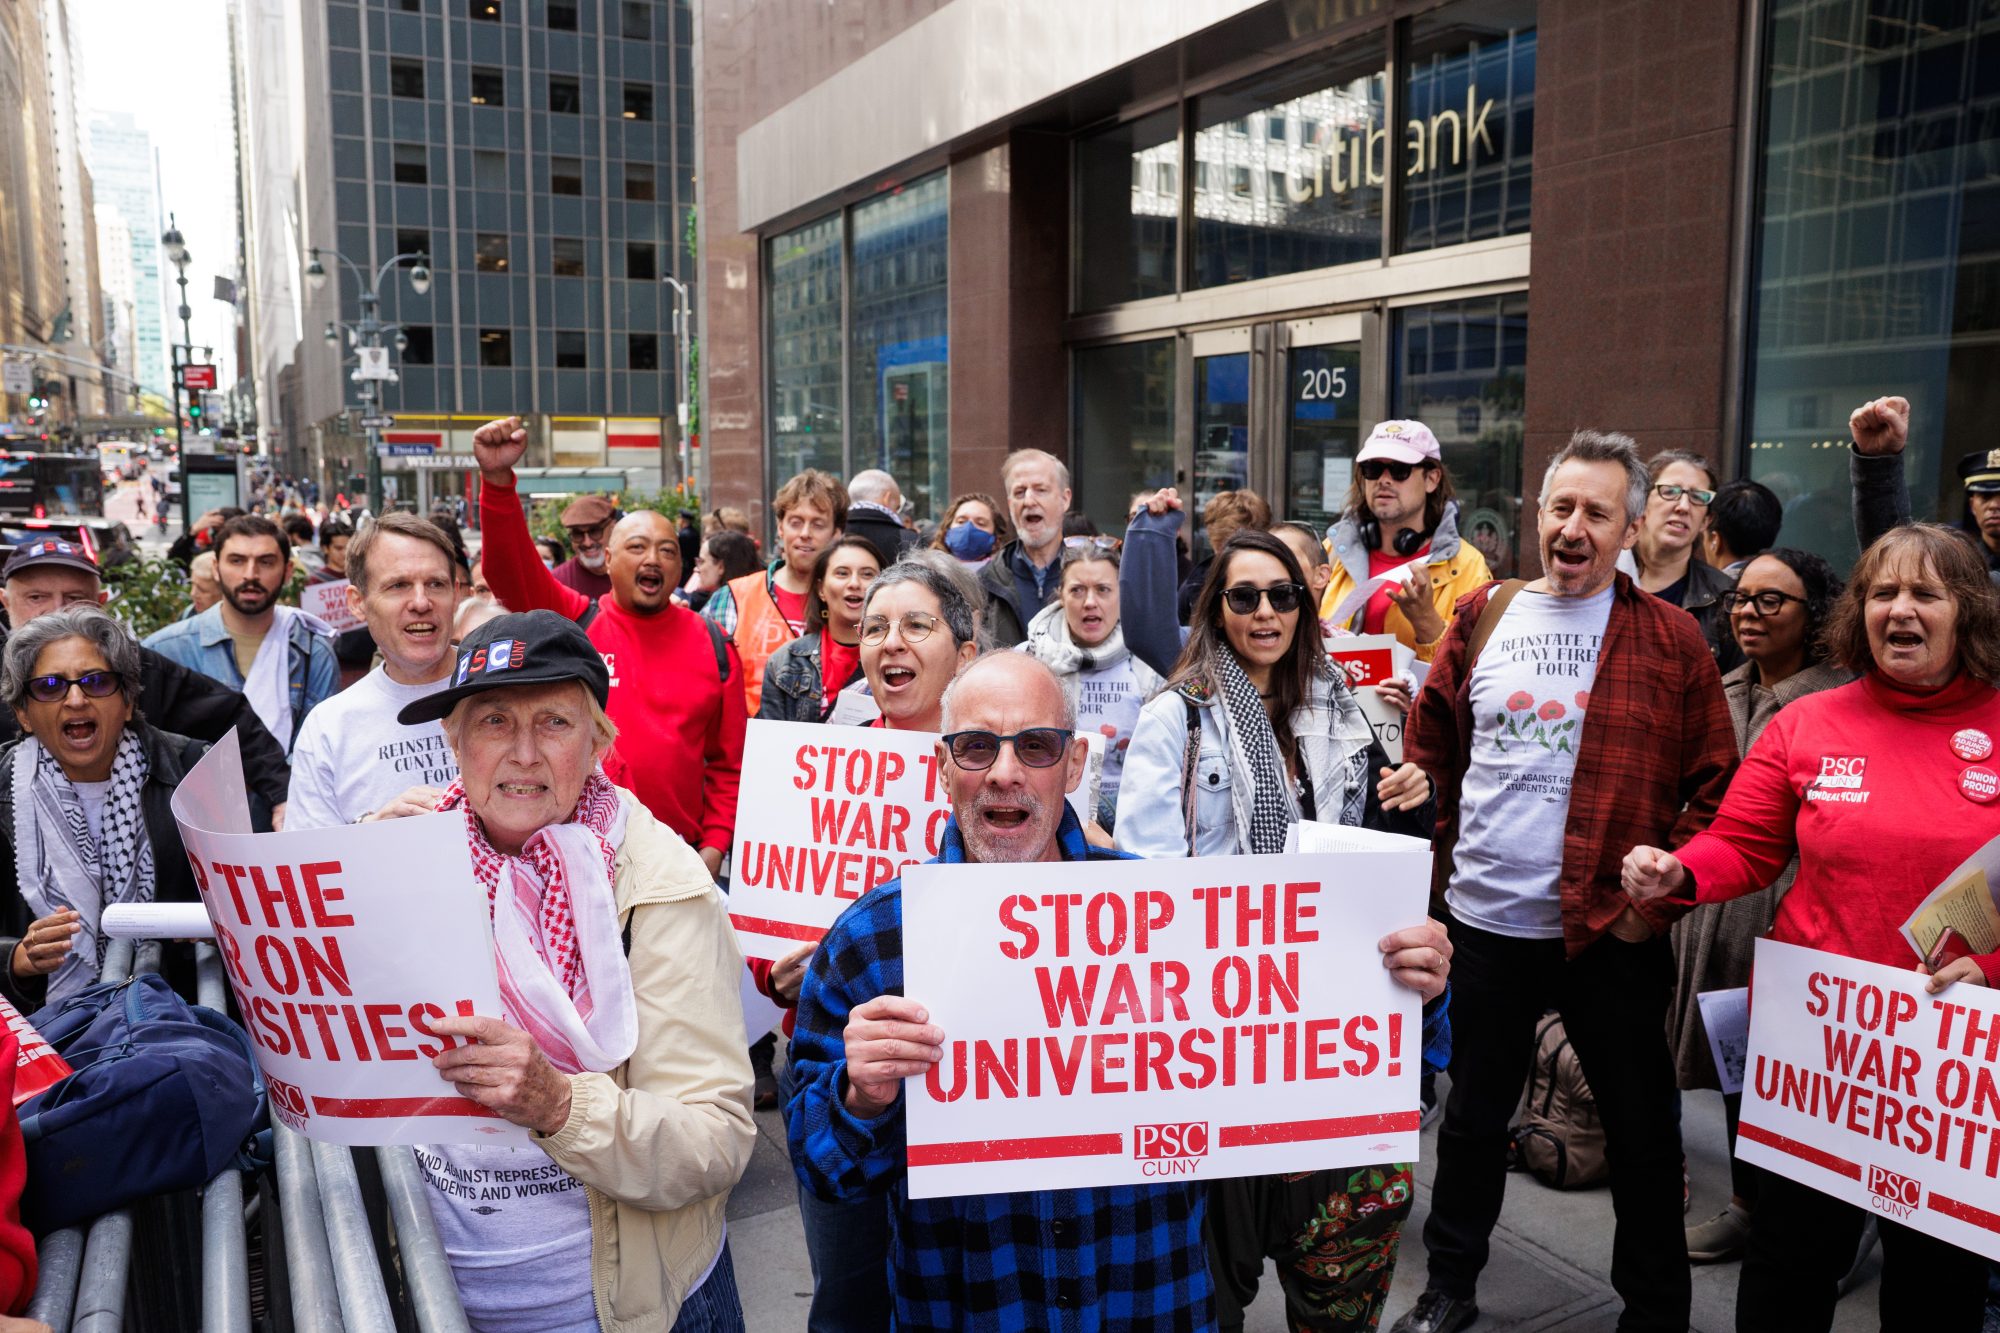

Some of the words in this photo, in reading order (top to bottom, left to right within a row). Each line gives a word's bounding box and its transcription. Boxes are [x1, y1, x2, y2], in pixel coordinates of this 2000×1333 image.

[1286, 85, 1494, 203] citibank
[1301, 367, 1347, 399] 205
[1501, 634, 1584, 652] REINSTATE
[1512, 648, 1550, 662] CUNY
[457, 641, 512, 685] PSC
[509, 639, 527, 668] CUNY
[1536, 663, 1579, 677] FOUR
[1080, 703, 1104, 715] OUR
[1087, 692, 1122, 704] FIRED
[1373, 722, 1400, 742] TO
[378, 734, 445, 760] REINSTA
[394, 752, 434, 773] CUNY
[792, 744, 906, 798] STOP
[1819, 756, 1866, 777] PSC
[1505, 783, 1548, 794] STUDENTS
[1550, 786, 1568, 796] AND
[1521, 773, 1557, 784] AGAINST
[1962, 779, 1996, 795] PROUD
[1966, 770, 1997, 785] UNION
[810, 797, 911, 852] WAR
[212, 861, 355, 928] THE
[999, 891, 1175, 960] STOP
[1193, 881, 1321, 949] THE
[254, 935, 353, 997] ON
[1034, 961, 1191, 1029] WAR
[1211, 951, 1300, 1019] ON
[1806, 971, 1918, 1037] STOP
[1932, 999, 2000, 1063] TH
[925, 1013, 1403, 1104] UNIVERSITIES!
[1823, 1024, 1922, 1098] WAR
[1754, 1054, 2000, 1179] UNIVERSITI
[1135, 1122, 1207, 1158] PSC
[444, 1160, 490, 1183] AGAINST
[494, 1163, 565, 1184] REPRESSI
[1142, 1158, 1201, 1178] CUNY
[424, 1169, 477, 1200] STUDENTS
[480, 1186, 511, 1201] AND
[1869, 1166, 1920, 1208] PSC
[1871, 1195, 1913, 1221] CUNY
